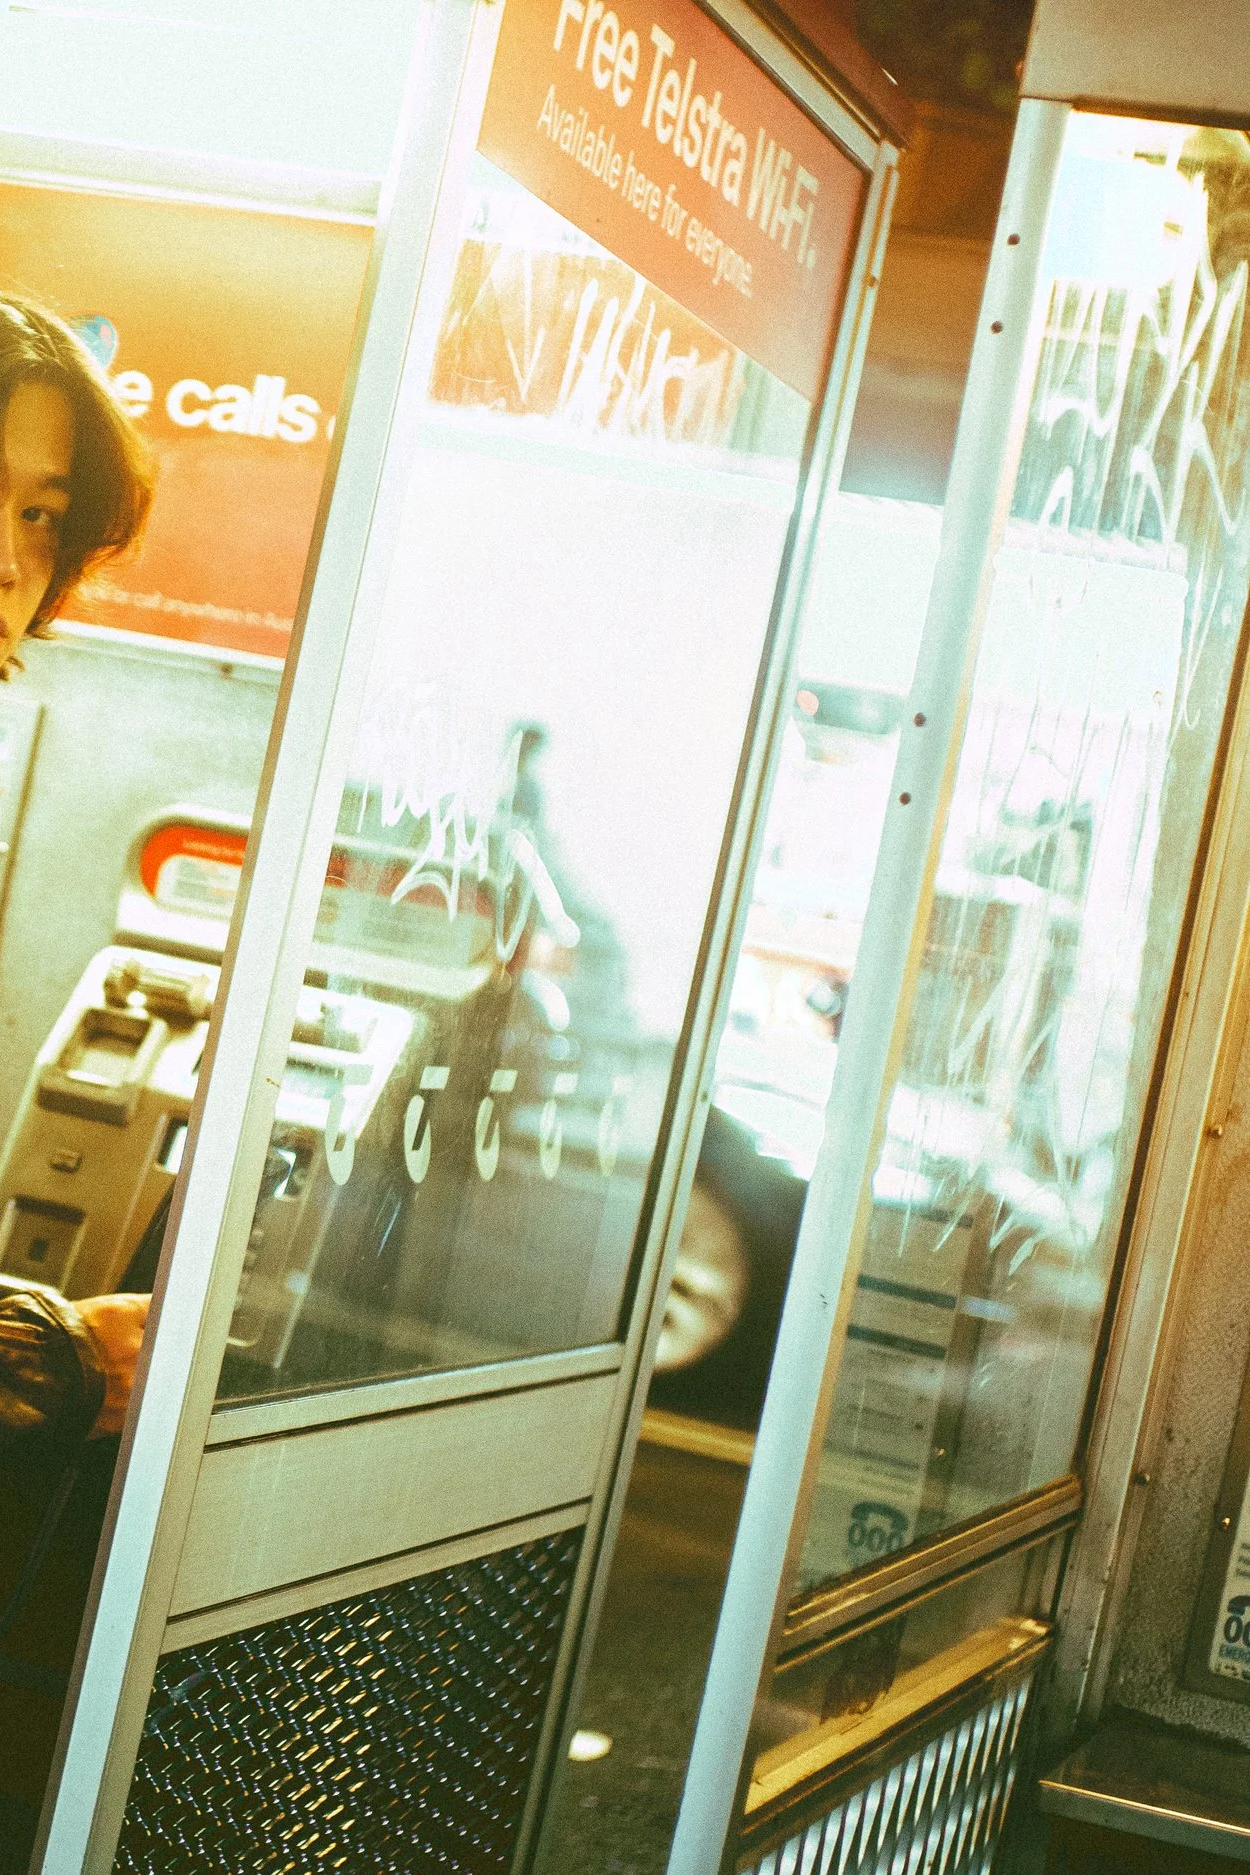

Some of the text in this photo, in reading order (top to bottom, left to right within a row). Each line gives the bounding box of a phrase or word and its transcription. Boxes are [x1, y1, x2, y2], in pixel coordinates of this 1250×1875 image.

[535, 82, 623, 190] Available
[621, 149, 663, 222] here
[660, 183, 688, 240] for
[553, 0, 639, 108] Free
[641, 24, 748, 208] Telstra
[165, 373, 322, 444] calls
